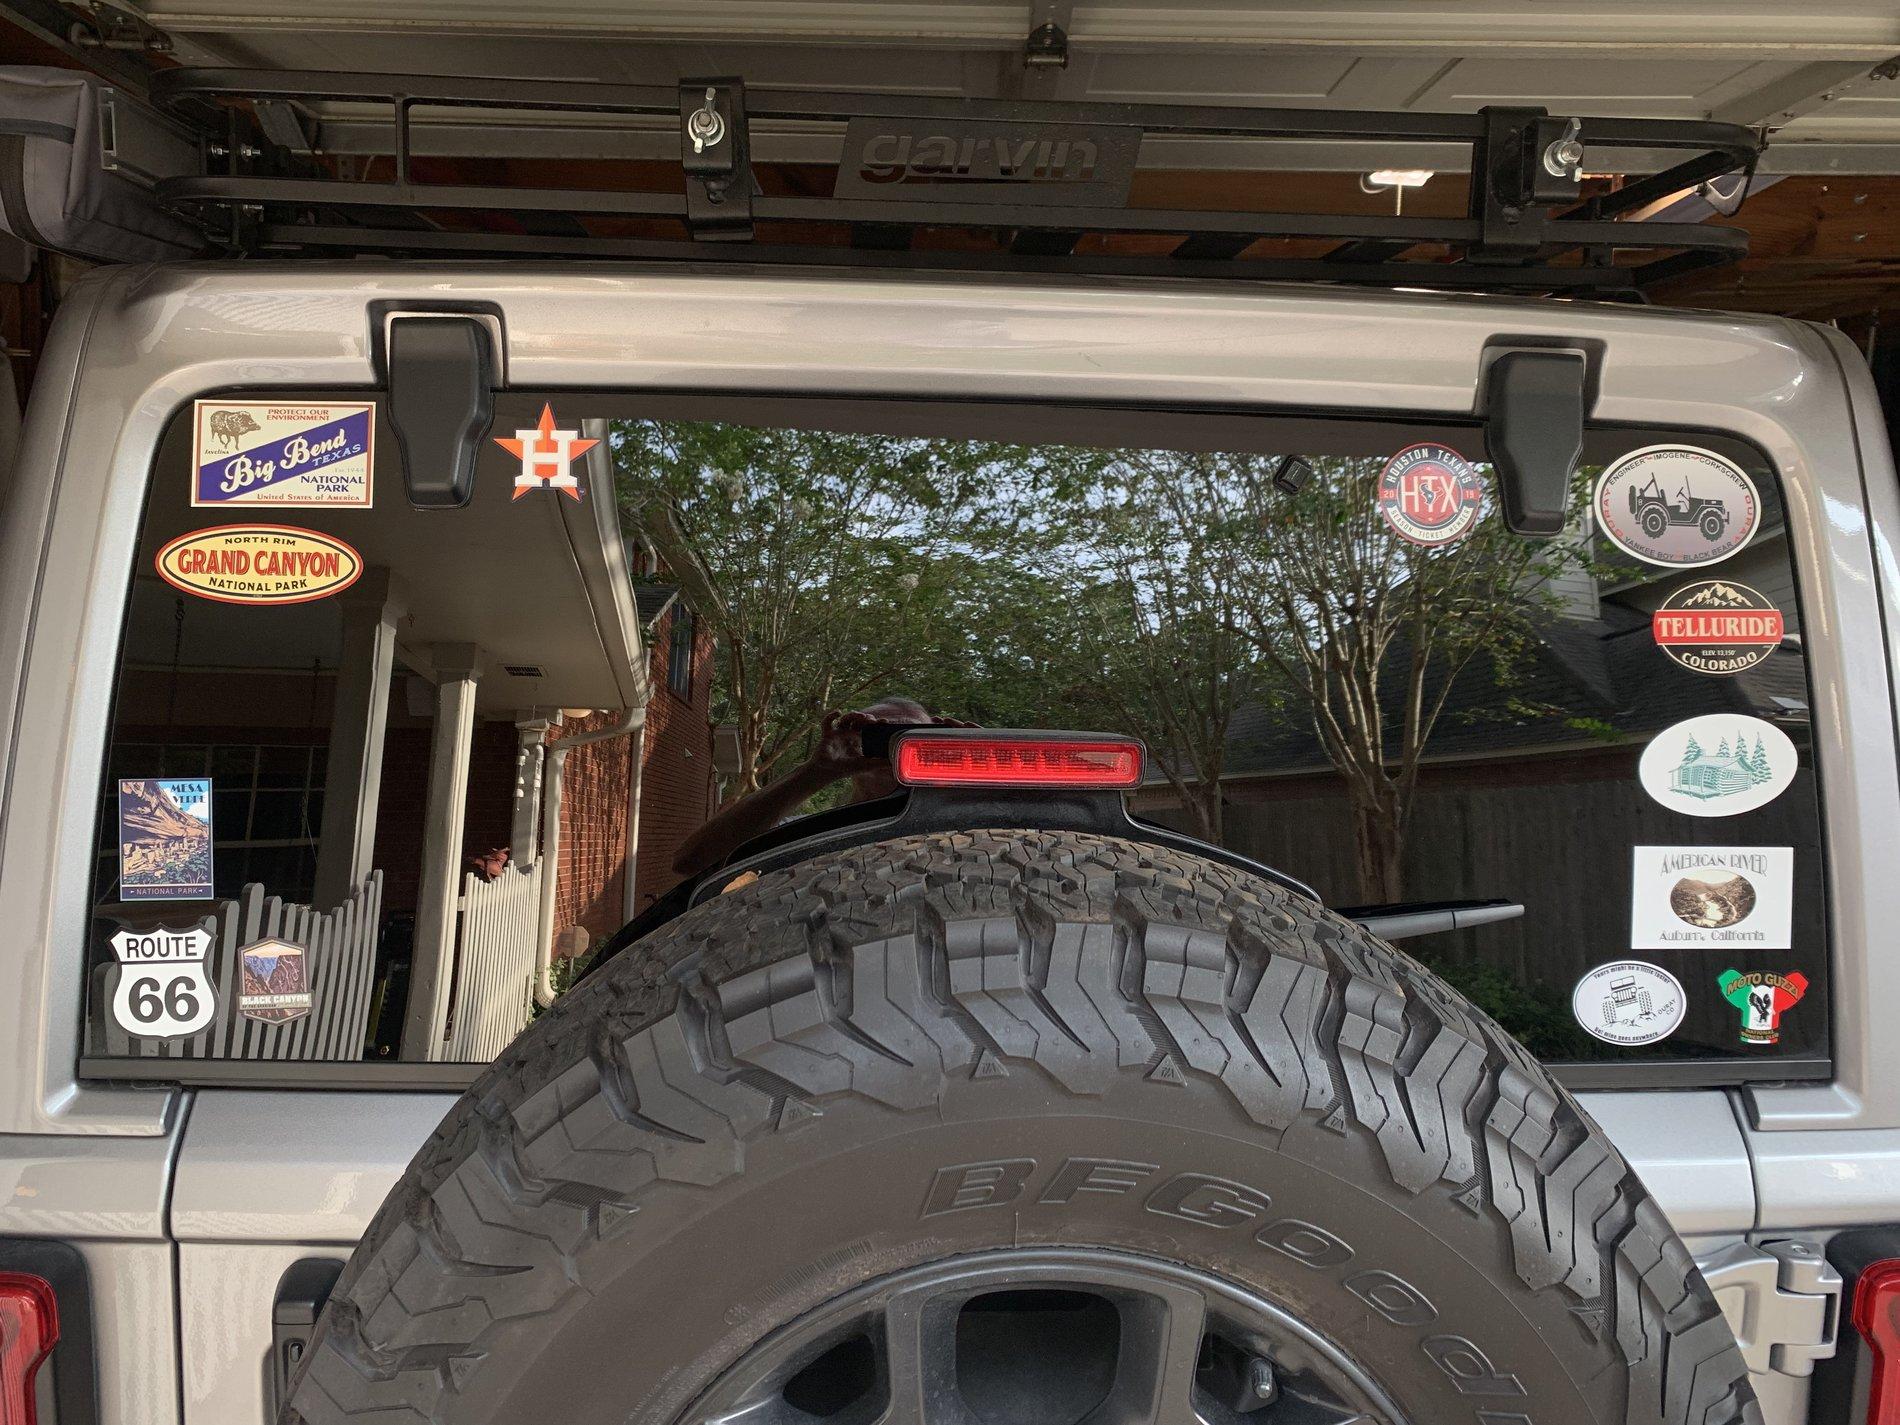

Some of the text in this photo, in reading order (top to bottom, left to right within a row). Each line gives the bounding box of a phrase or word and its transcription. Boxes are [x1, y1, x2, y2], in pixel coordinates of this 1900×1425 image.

[860, 133, 1099, 184] garvin
[267, 408, 329, 416] PROTECT OUR
[220, 428, 347, 493] Big Bend
[312, 443, 362, 467] TEXAS
[514, 429, 578, 488] H
[1385, 448, 1473, 484] HOUSTON TEXANS
[300, 475, 366, 485] NATIONAL
[1609, 452, 1748, 490] ENGINEER IMOGENE CORKSCREW
[314, 493, 325, 501] of
[316, 484, 349, 493] PARK
[1400, 475, 1459, 513] HTX
[1390, 509, 1470, 539] SEASON TICKET MEMBER
[224, 536, 296, 546] NORTH RIM
[1624, 536, 1734, 561] YANKEE BOY BLACK BEAR
[177, 549, 341, 577] GRAND CANYON
[209, 577, 308, 592] NATIONAL PARK
[1657, 616, 1778, 638] TELLURIDE
[1681, 651, 1758, 671] COLORADO
[171, 783, 204, 793] MESA
[1660, 853, 1768, 877] AMERICAN RIVER
[136, 887, 175, 895] NATIONAL
[1710, 929, 1765, 941] California
[126, 936, 198, 958] ROUTE
[1727, 972, 1761, 995] MOTO
[128, 975, 200, 1024] 66
[241, 994, 309, 1005] BLACK CANYON
